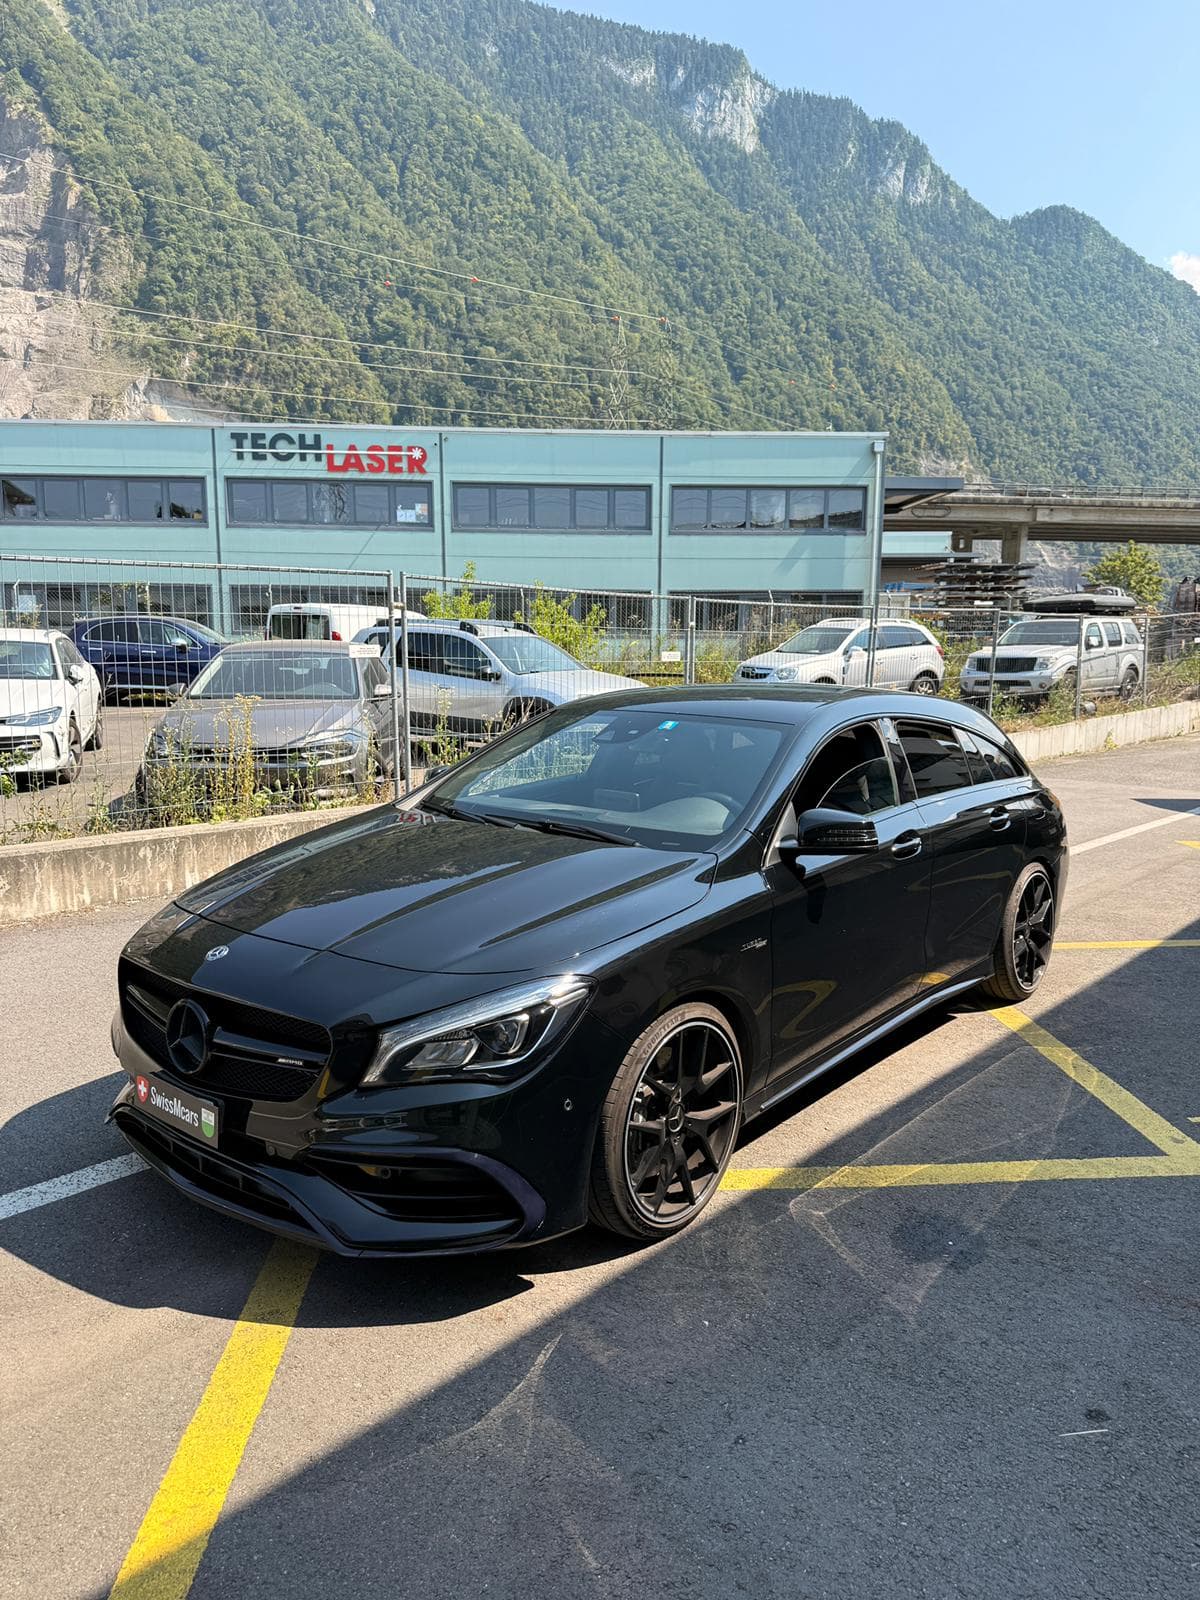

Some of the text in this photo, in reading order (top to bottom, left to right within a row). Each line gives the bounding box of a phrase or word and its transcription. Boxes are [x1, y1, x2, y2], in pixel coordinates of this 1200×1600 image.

[230, 432, 428, 474] TECH LASER
[150, 1086, 199, 1126] SwissMcars
